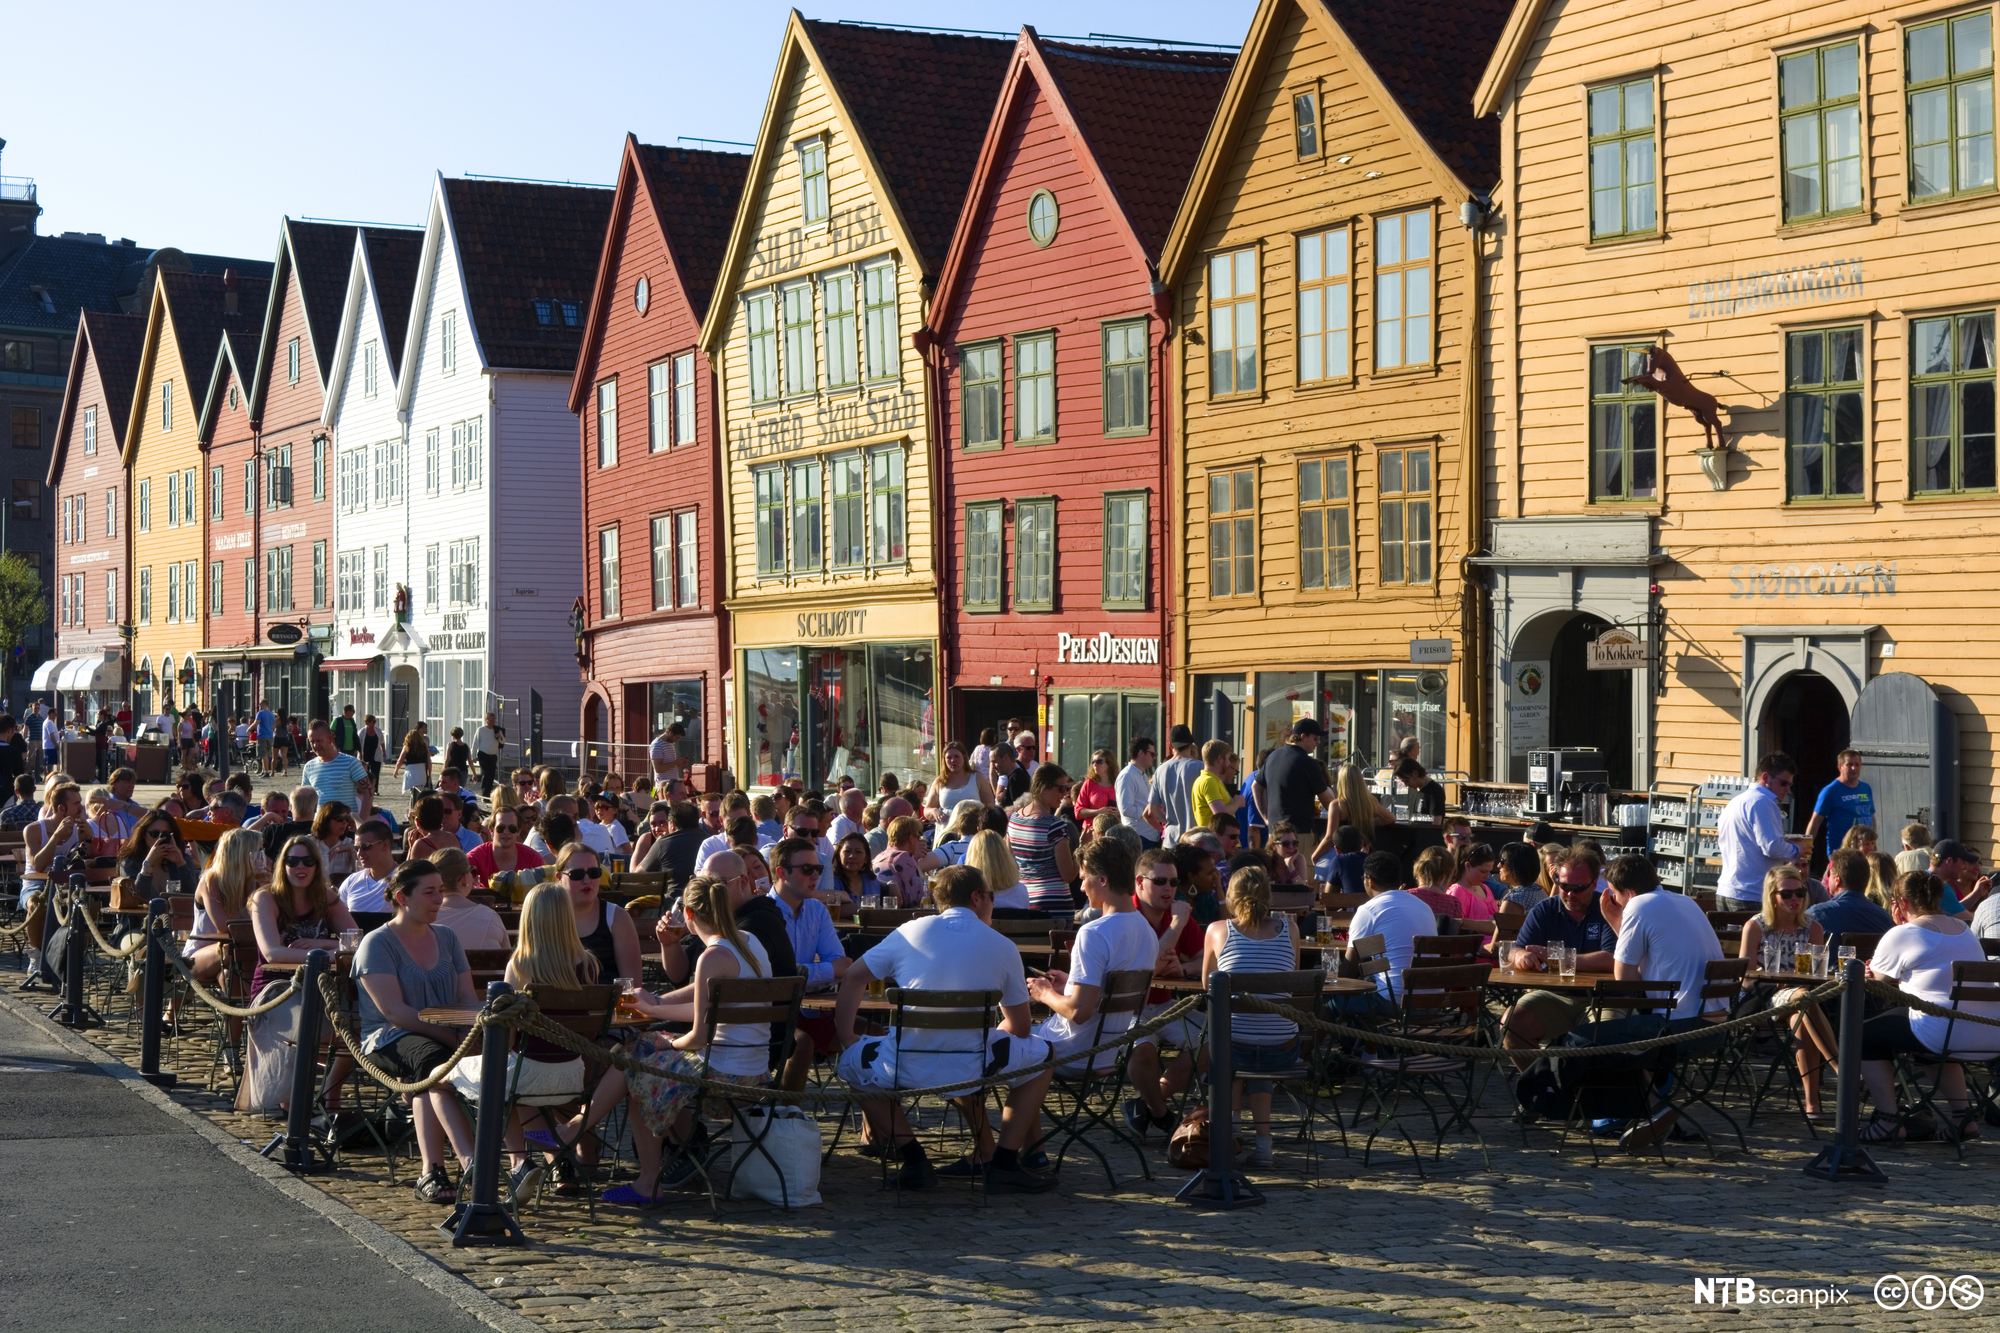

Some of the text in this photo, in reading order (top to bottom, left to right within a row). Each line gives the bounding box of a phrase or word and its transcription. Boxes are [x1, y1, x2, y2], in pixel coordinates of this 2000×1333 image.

[754, 227, 803, 280] SILD
[1688, 257, 1864, 319] ENHJØRNINGEN
[736, 390, 917, 460] ALFRED SKULSTAD
[1729, 562, 1897, 600] SJØBODEN
[797, 609, 867, 637] SCHJØTT
[1601, 632, 1636, 641] RESTAURANT
[429, 631, 486, 651] SILVER GALLERY
[1592, 645, 1644, 661] To Kokker
